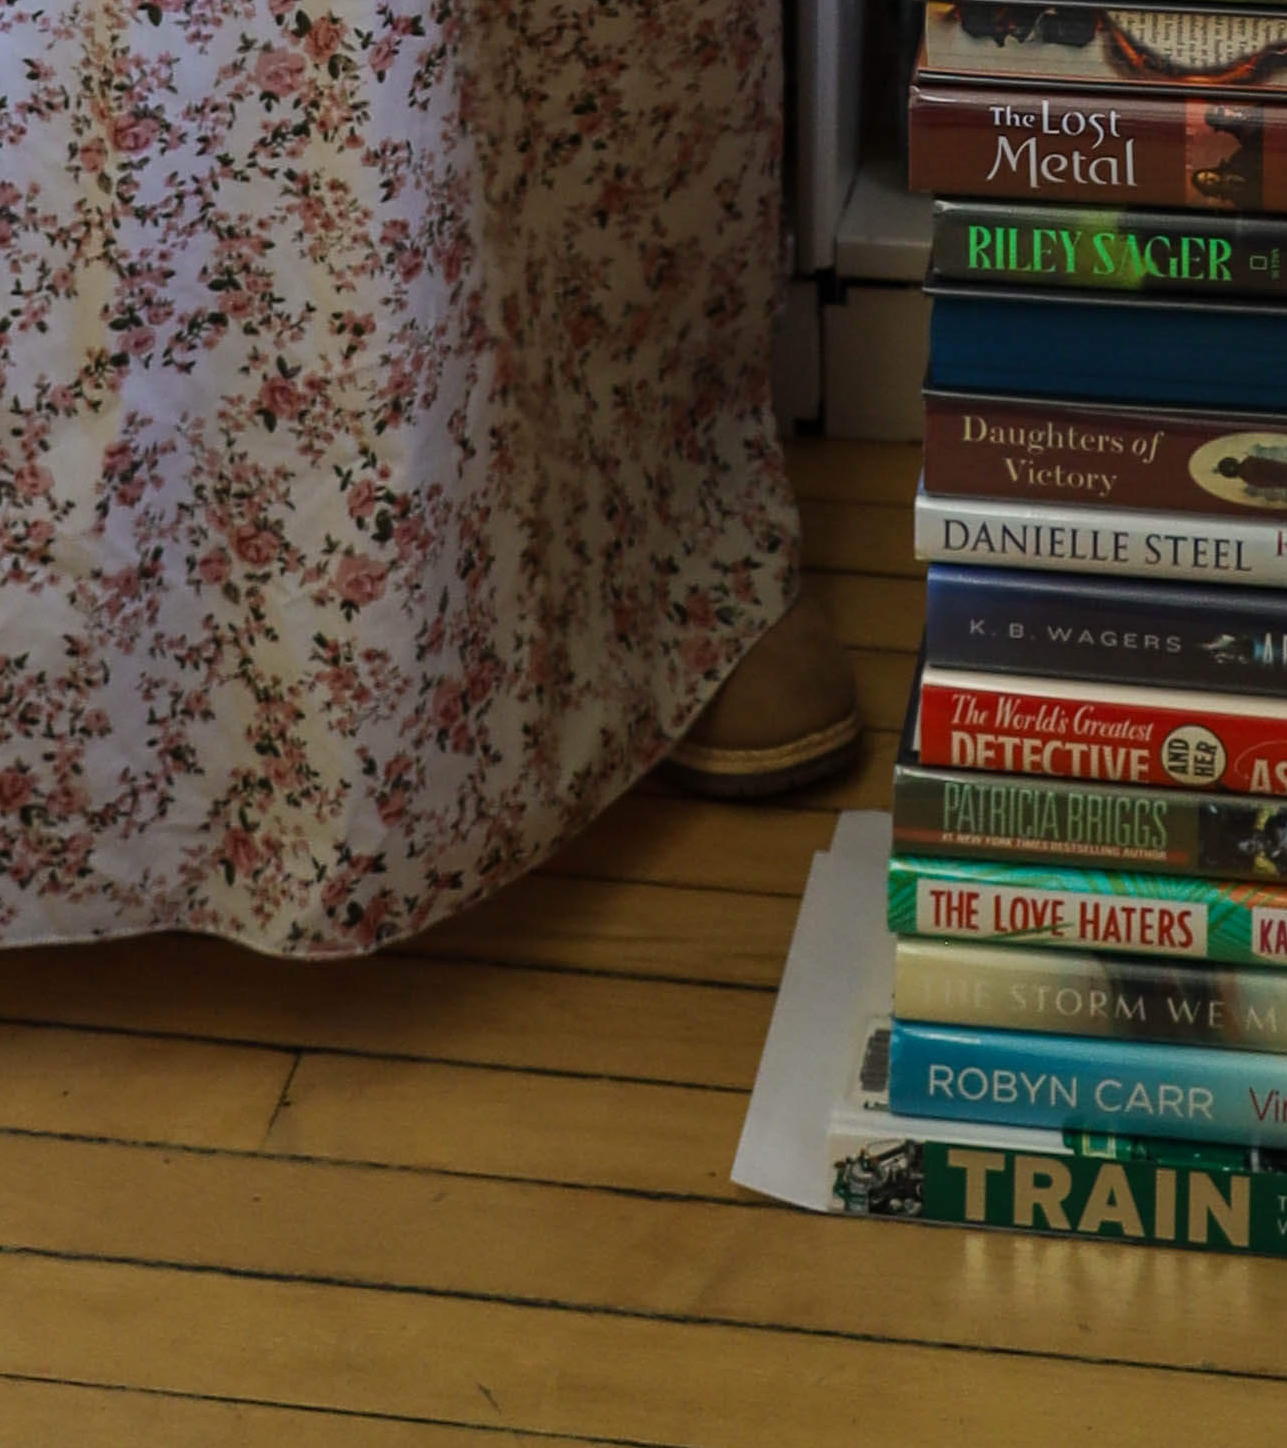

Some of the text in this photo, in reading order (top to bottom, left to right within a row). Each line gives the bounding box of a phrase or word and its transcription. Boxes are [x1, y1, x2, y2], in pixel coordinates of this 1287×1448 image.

[987, 137, 1138, 188] Metal
[962, 415, 1123, 457] Daughters
[942, 519, 1252, 572] DANIELLE STEEL
[930, 890, 1193, 949] THE LOVE HATERS
[929, 1065, 1077, 1107] ROBYN
[1095, 1080, 1214, 1119] CARR
[948, 1149, 1250, 1247] TRAIN
